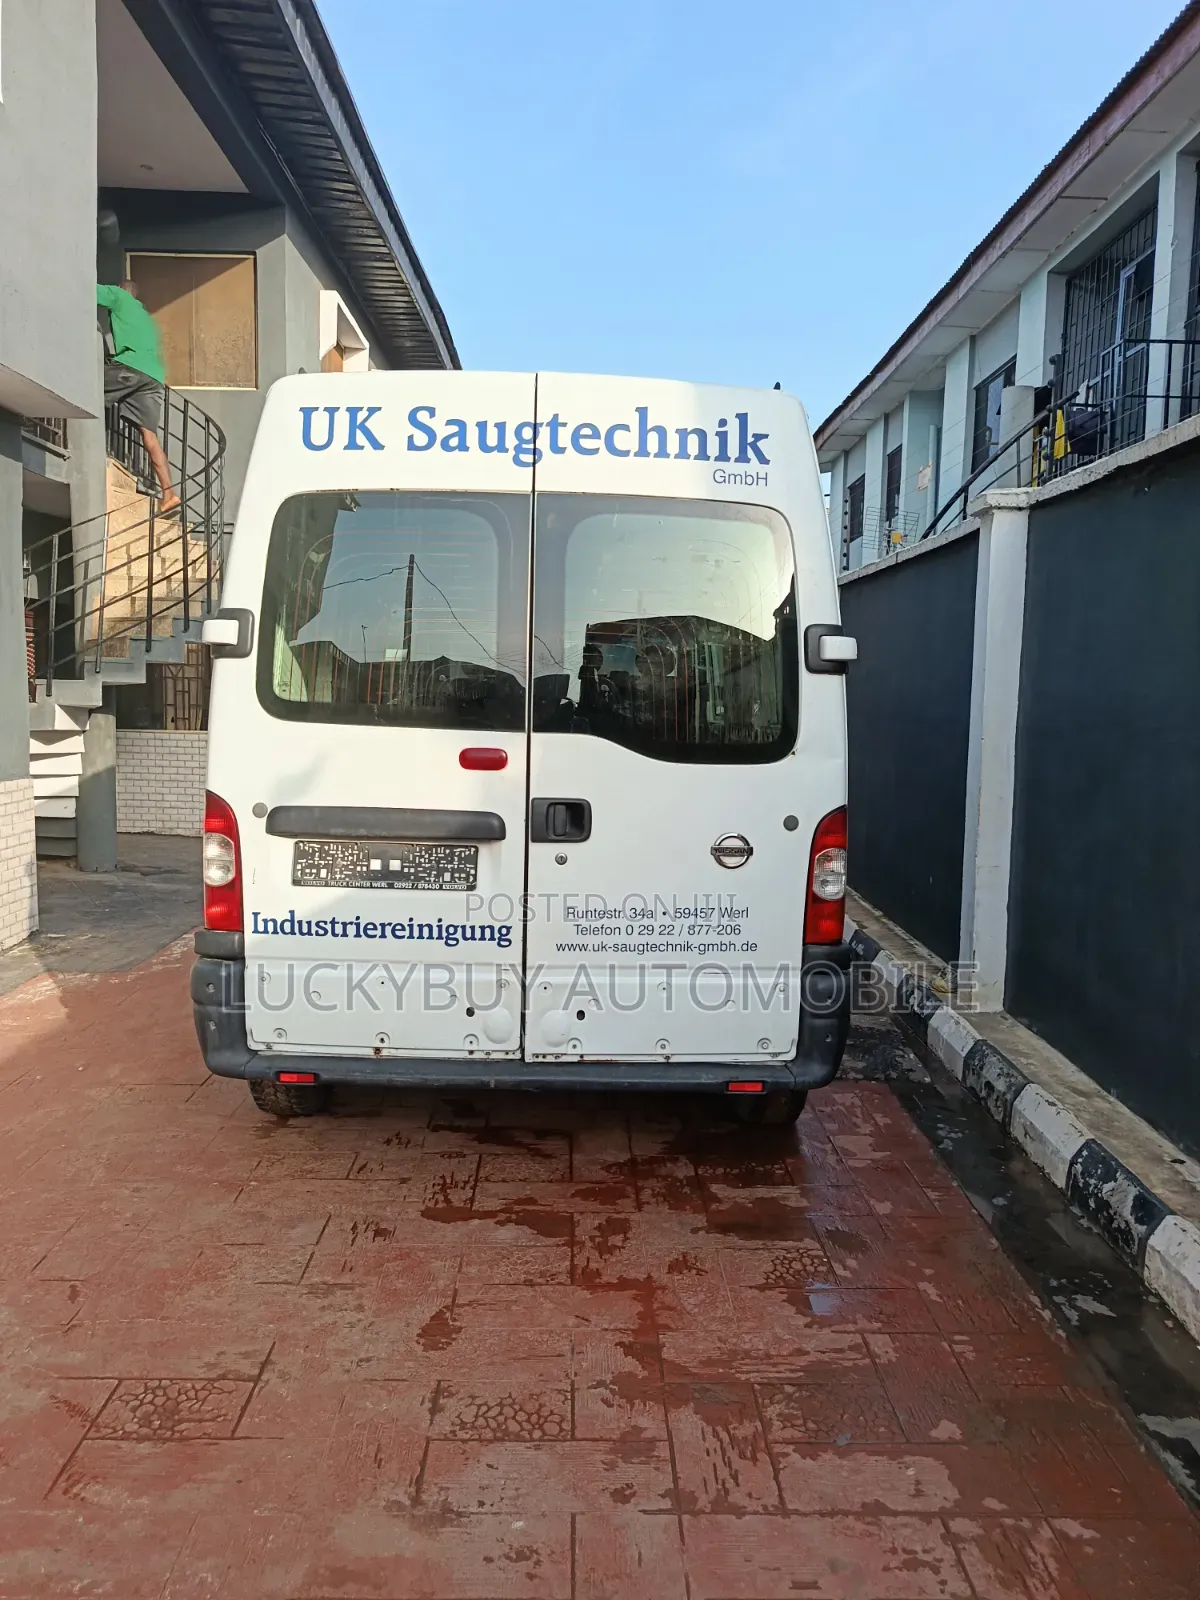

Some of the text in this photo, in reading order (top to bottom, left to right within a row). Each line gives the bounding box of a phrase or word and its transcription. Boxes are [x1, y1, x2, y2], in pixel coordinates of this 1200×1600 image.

[299, 405, 771, 467] UK Saugtechnik
[712, 469, 768, 487] GmbH
[566, 906, 749, 919] Runtestr. 34a 59457 Werl
[251, 910, 513, 948] Industriereinigung
[573, 924, 621, 936] Telefon
[625, 924, 634, 936] 0
[638, 924, 655, 936] 29
[658, 924, 675, 936] 22
[687, 924, 742, 936] 877-206
[556, 940, 758, 956] www.uk-saugtechnik-gmbh.de
